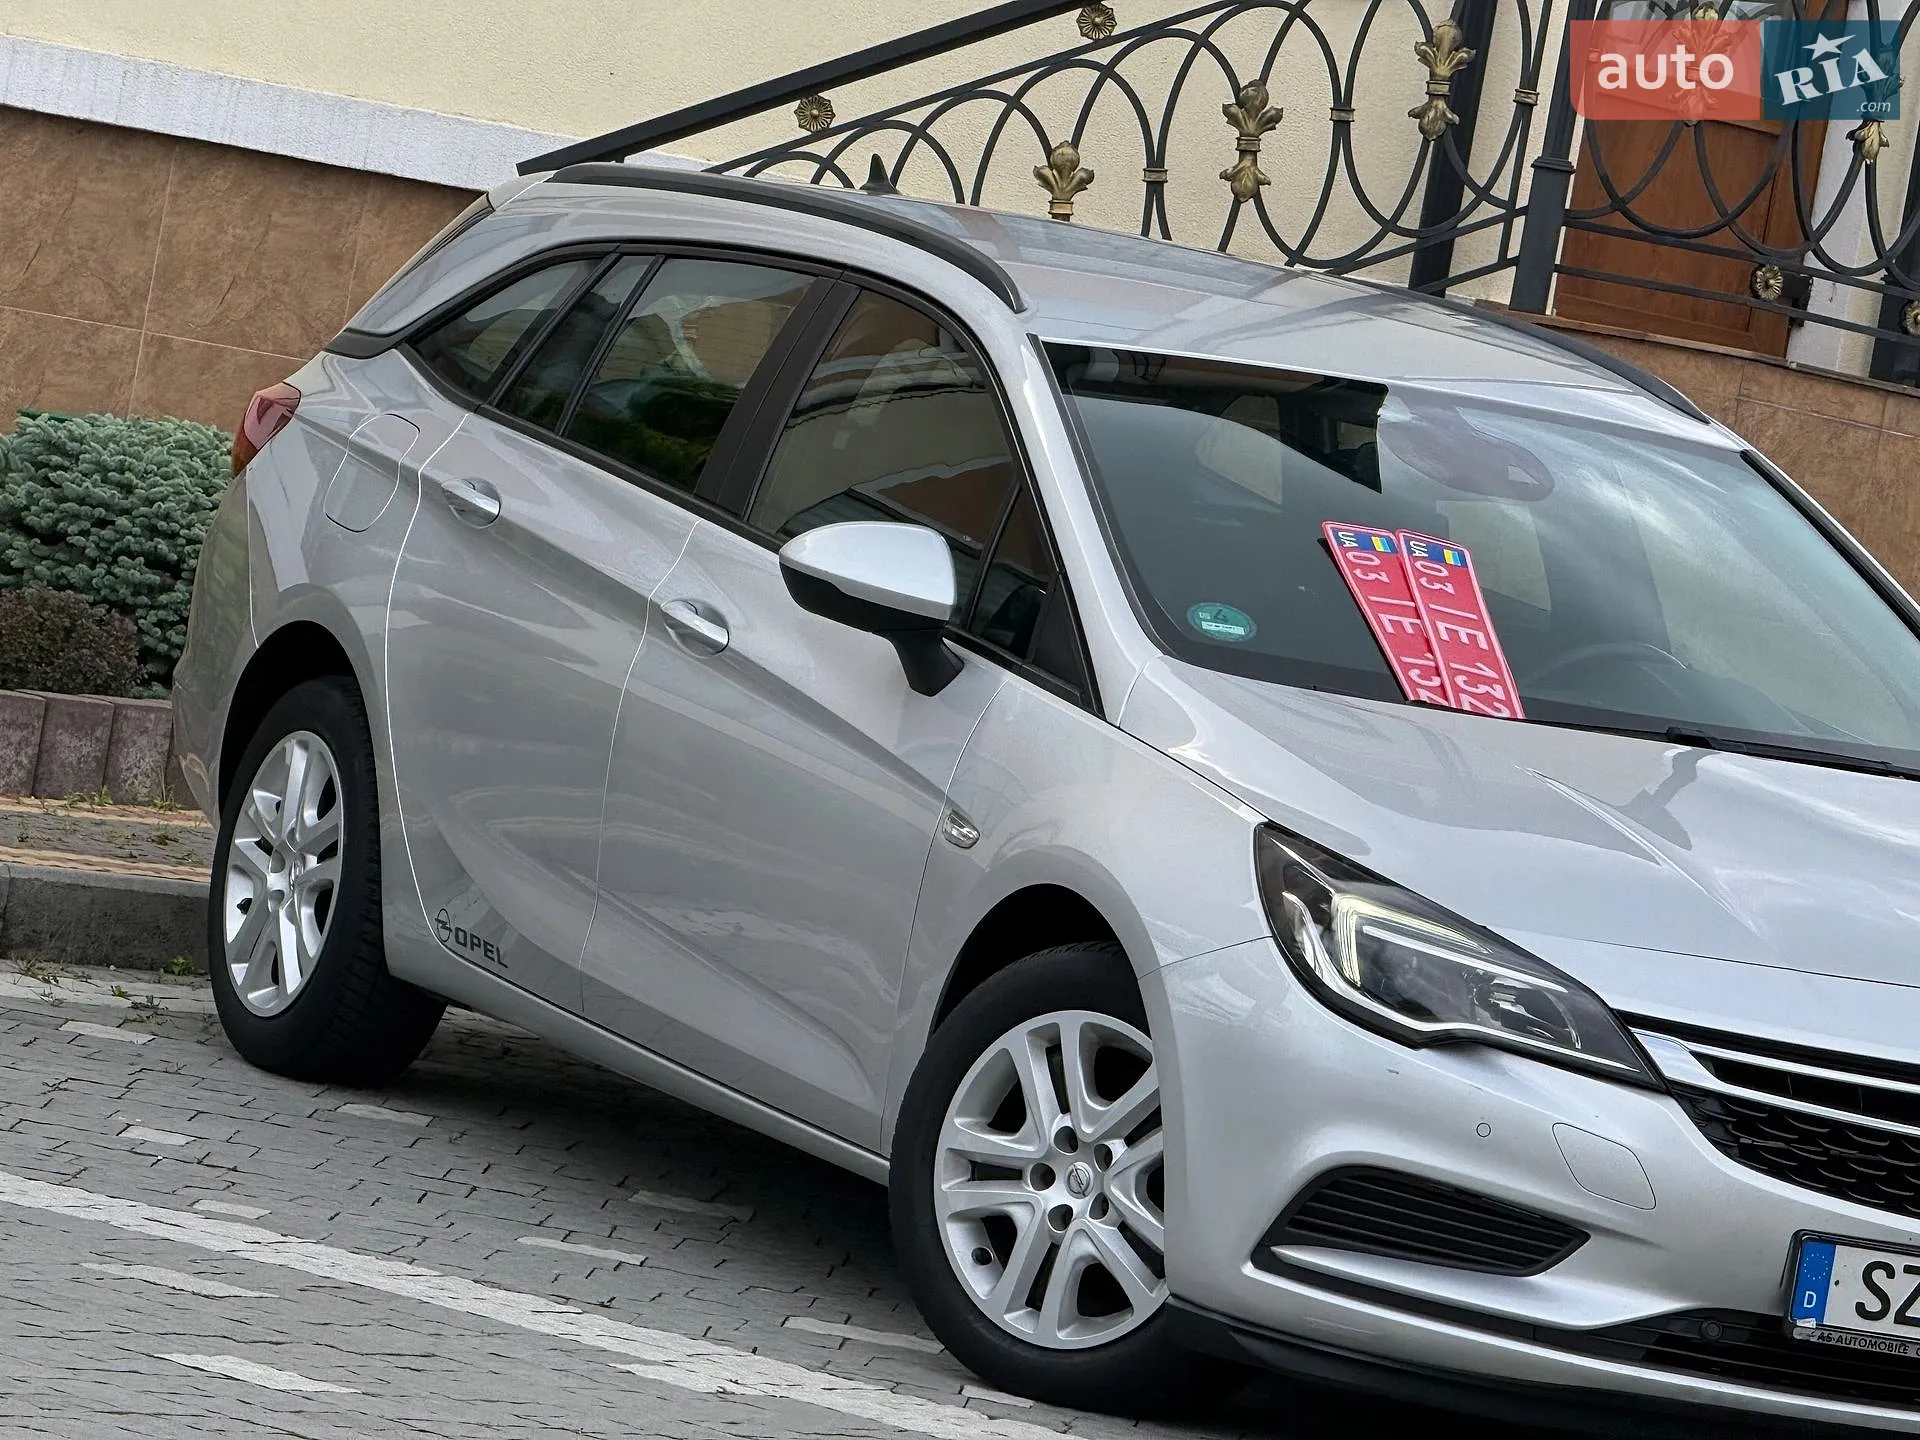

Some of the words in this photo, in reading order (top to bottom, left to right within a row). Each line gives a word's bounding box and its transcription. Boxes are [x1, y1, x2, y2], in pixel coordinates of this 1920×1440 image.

[1338, 531, 1359, 548] UA
[1409, 540, 1429, 558] UA
[1345, 551, 1390, 583] 03
[1414, 560, 1456, 596] 03
[454, 926, 509, 969] OPEL
[1803, 1290, 1817, 1308] D
